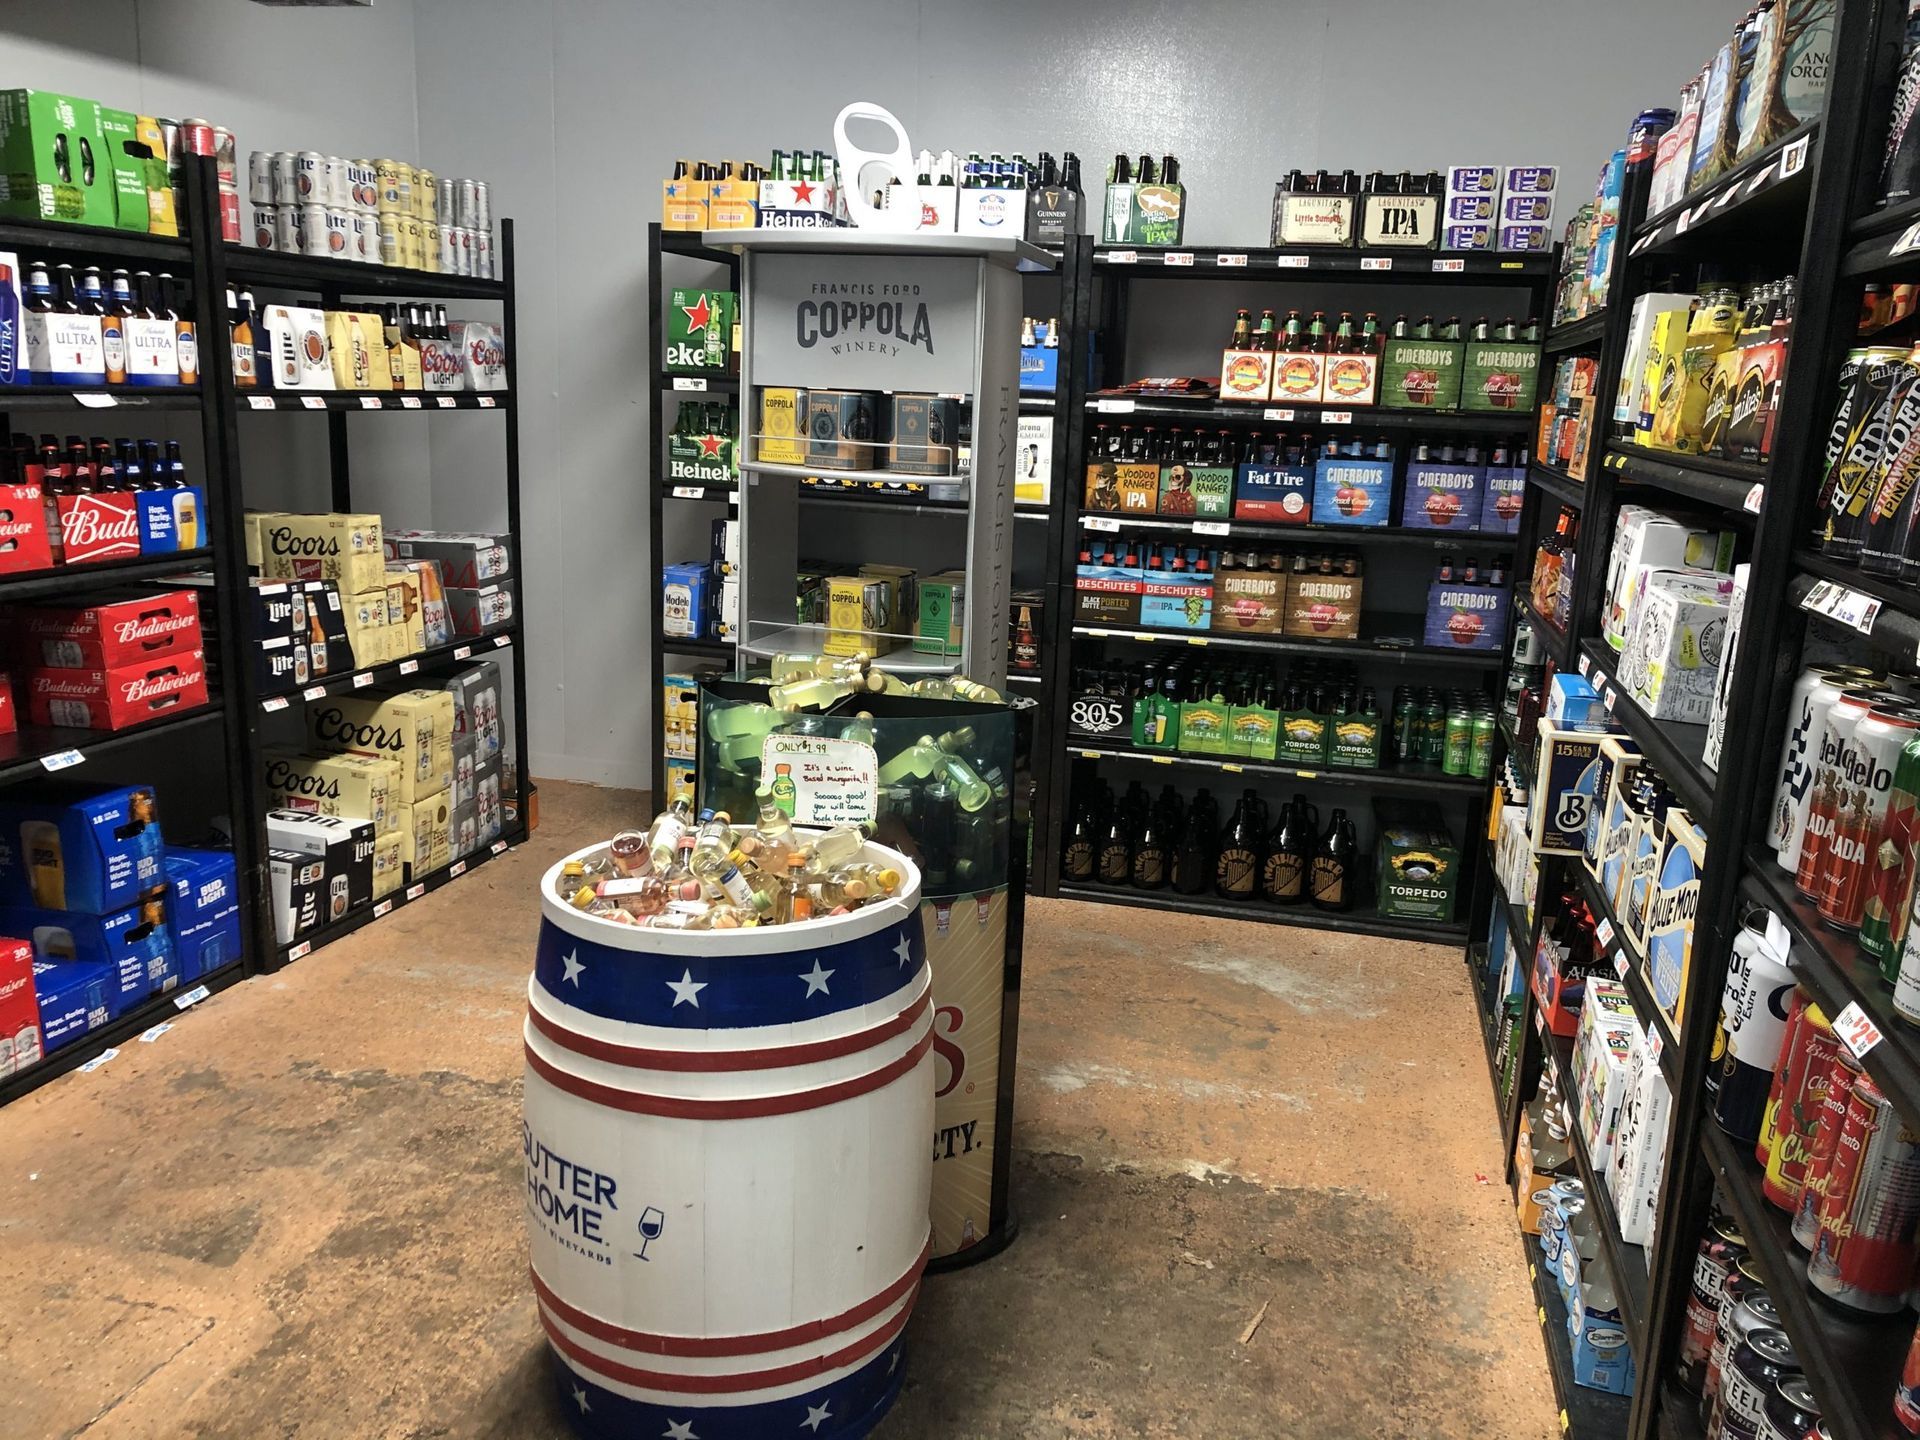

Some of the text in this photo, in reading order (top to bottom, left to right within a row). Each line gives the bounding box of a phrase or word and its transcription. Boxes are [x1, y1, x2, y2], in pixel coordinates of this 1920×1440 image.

[1465, 169, 1482, 191] ALE
[1522, 169, 1540, 191] ALE
[1463, 198, 1479, 219] ALE
[1519, 198, 1536, 219] ALE
[254, 212, 275, 226] Lite
[1381, 208, 1419, 235] IPA
[1146, 231, 1168, 243] IPA
[1460, 226, 1476, 248] ALE
[1516, 227, 1531, 248] ALE
[812, 283, 920, 296] FRANCIS FORD
[797, 300, 934, 355] COPPOLA
[0, 318, 13, 373] ULTRA
[56, 332, 97, 345] ULTRA
[135, 336, 172, 349] ULTRA
[236, 344, 251, 358] Lite
[831, 342, 900, 357] WINERY
[1395, 347, 1453, 366] CIDERBOYS
[422, 346, 464, 373] Coors
[1476, 350, 1536, 369] CIDERBOYS
[432, 373, 455, 385] LIGHT
[766, 398, 794, 409] COPPOLA
[811, 402, 838, 413] COPPOLA
[902, 404, 923, 413] COPPOLA
[1729, 386, 1761, 430] mike's
[1123, 468, 1156, 480] VOODOO
[1195, 472, 1229, 484] VOODOO
[1247, 470, 1304, 486] Fat Tire
[1327, 467, 1383, 484] CIDERBOYS
[1417, 472, 1474, 489] CIDERBOYS
[1123, 479, 1155, 490] RANGER
[1195, 483, 1228, 494] RANGER
[1126, 492, 1147, 508] IPA
[1197, 495, 1225, 504] IMPERIAL
[148, 506, 167, 514] Hops.
[1204, 502, 1217, 512] IPA
[149, 514, 171, 522] Barley.
[150, 522, 171, 530] Water.
[150, 530, 167, 538] Rice.
[269, 527, 341, 556] Coors
[1077, 579, 1137, 592] DESCHUTES
[1146, 584, 1207, 597] DESCHUTES
[1225, 578, 1276, 594] CIDERBOYS
[1300, 582, 1351, 599] CIDERBOYS
[665, 593, 689, 606] Modelo
[832, 593, 861, 604] COPPOLA
[1083, 596, 1130, 608] BLACK PORTER
[1440, 592, 1497, 609] CIDERBOYS
[268, 602, 291, 623] Lite
[1082, 602, 1100, 610] BUTTE
[1161, 602, 1173, 611] IPA
[84, 612, 95, 620] 12
[114, 614, 195, 643] Budweiser
[1702, 626, 1714, 646] HARD
[271, 656, 294, 675] Lite
[92, 672, 102, 680] 12
[34, 677, 99, 694] Budweiser
[121, 671, 201, 703] Budweiser
[1070, 701, 1123, 726] 805
[314, 708, 405, 751] Coors
[1184, 730, 1204, 738] PALE
[1233, 734, 1271, 744] PALE ALE
[1285, 741, 1320, 750] TORPEDO
[776, 741, 827, 753] ONLY $1.99
[1336, 745, 1373, 755] TORPEDO
[1556, 744, 1572, 756] 15
[1573, 744, 1591, 752] CANS
[804, 764, 820, 772] It's
[265, 760, 341, 799] Coors
[803, 774, 824, 783] Based
[846, 790, 867, 804] good!
[812, 803, 826, 814] you
[831, 802, 845, 810] will
[813, 814, 831, 822] back
[848, 813, 871, 822] more!
[354, 840, 375, 862] Lite
[109, 854, 128, 864] Hops.
[1217, 849, 1257, 876] MOTHER
[1264, 853, 1303, 879] MOTHER
[109, 861, 132, 872] Barley.
[1227, 860, 1249, 885] ROAD
[110, 870, 132, 881] Water.
[1275, 865, 1297, 892] ROAD
[110, 880, 127, 890] Rice.
[177, 880, 188, 890] 30
[200, 879, 223, 896] BUD
[331, 880, 347, 895] Lite
[198, 886, 227, 908] LIGHT
[1389, 886, 1448, 900] TORPEDO
[300, 891, 317, 928] Lite
[1651, 886, 1676, 932] BLUE
[14, 948, 28, 959] 30
[119, 956, 138, 967] Hops.
[120, 963, 143, 976] Barley.
[121, 972, 143, 983] Water.
[121, 982, 138, 992] Rice.
[1742, 989, 1758, 1020] Extra
[1502, 1018, 1513, 1056] PILSNER
[524, 1120, 618, 1210] SUTTER
[527, 1167, 610, 1247] HOME.
[549, 1229, 612, 1266] VINEYARDS
